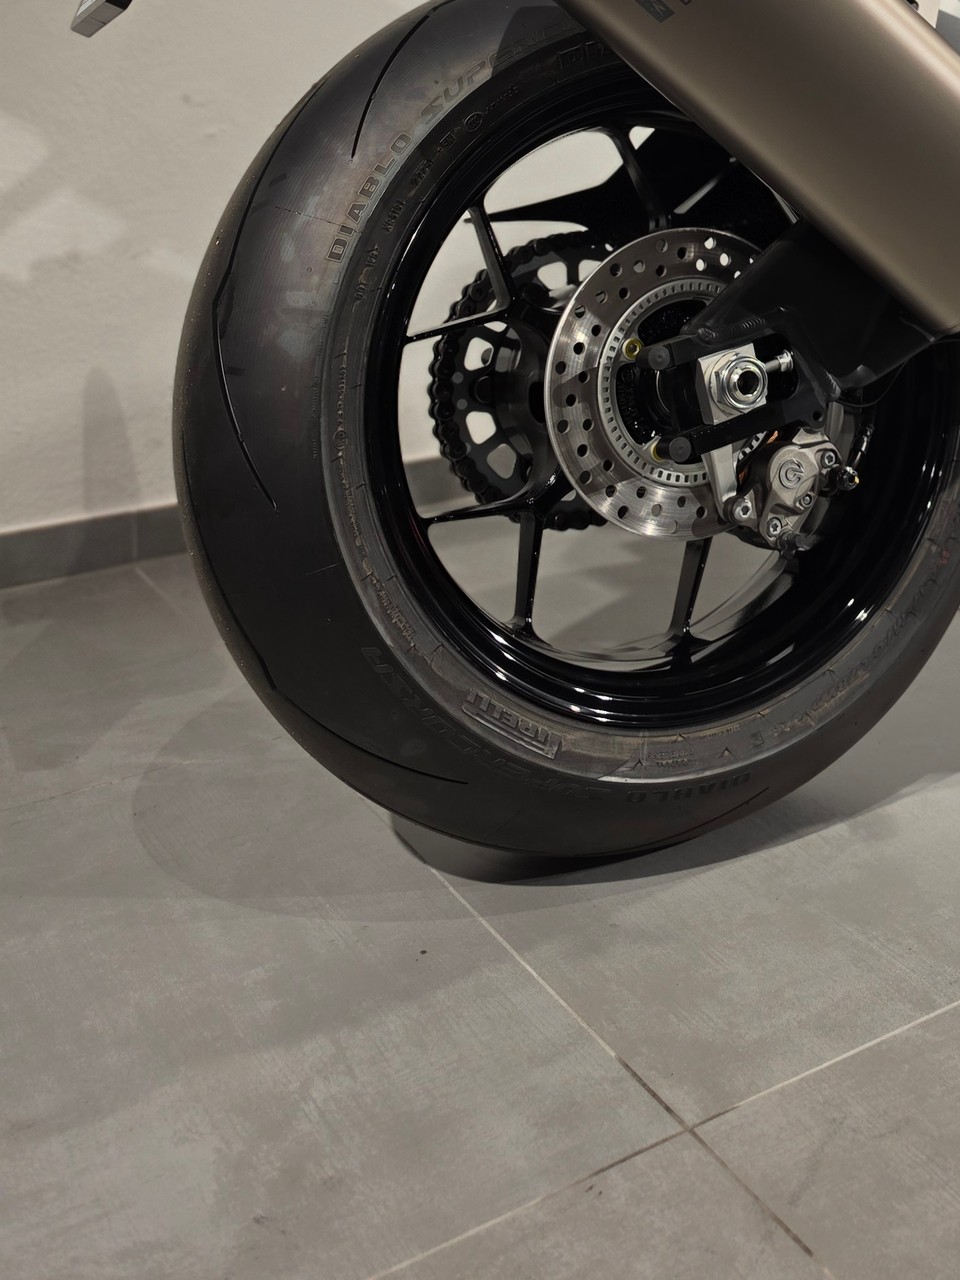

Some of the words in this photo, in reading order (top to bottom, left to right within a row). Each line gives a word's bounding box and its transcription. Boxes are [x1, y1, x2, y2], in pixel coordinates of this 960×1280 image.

[325, 131, 413, 263] DIABLO
[462, 687, 562, 760] PIRELLI
[625, 772, 751, 804] DIABLO
